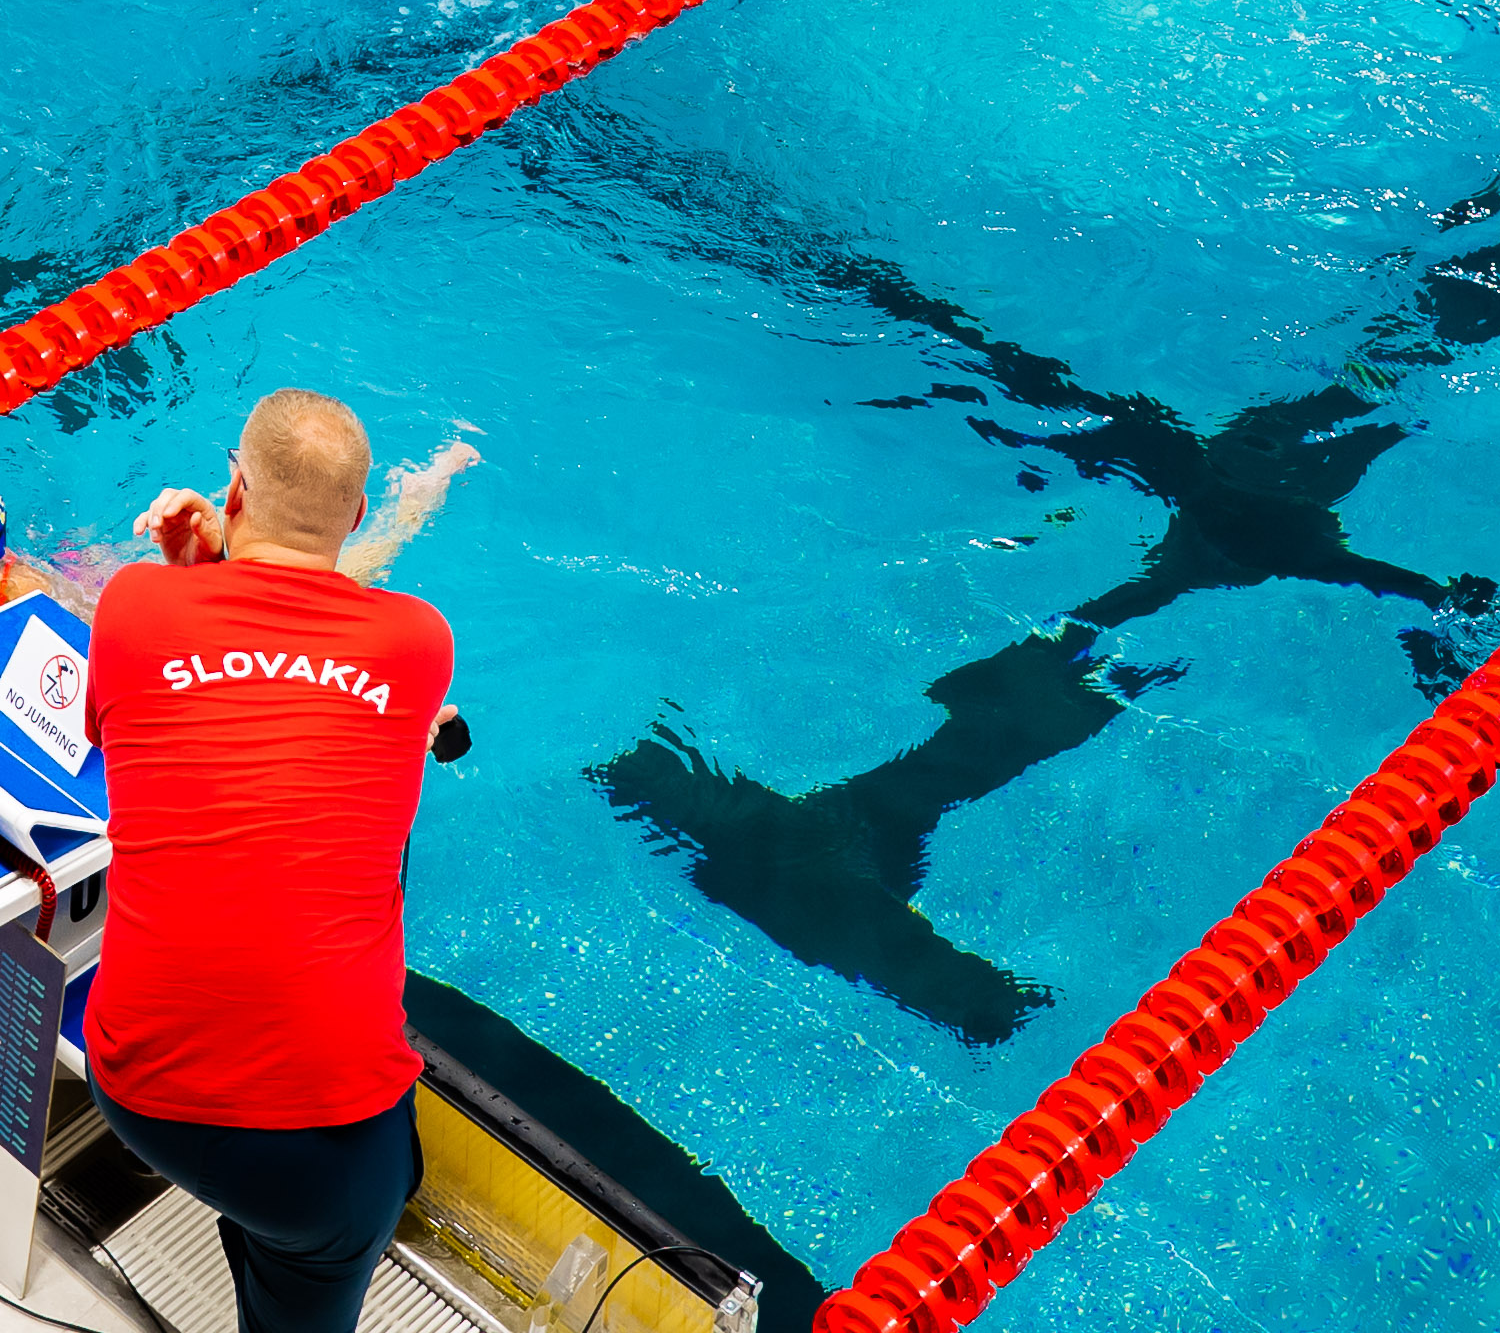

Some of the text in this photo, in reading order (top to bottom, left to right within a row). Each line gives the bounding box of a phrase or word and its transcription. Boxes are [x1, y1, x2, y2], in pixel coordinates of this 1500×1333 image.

[162, 651, 391, 715] SLOVAKIA
[4, 687, 79, 759] NO JUMPING
